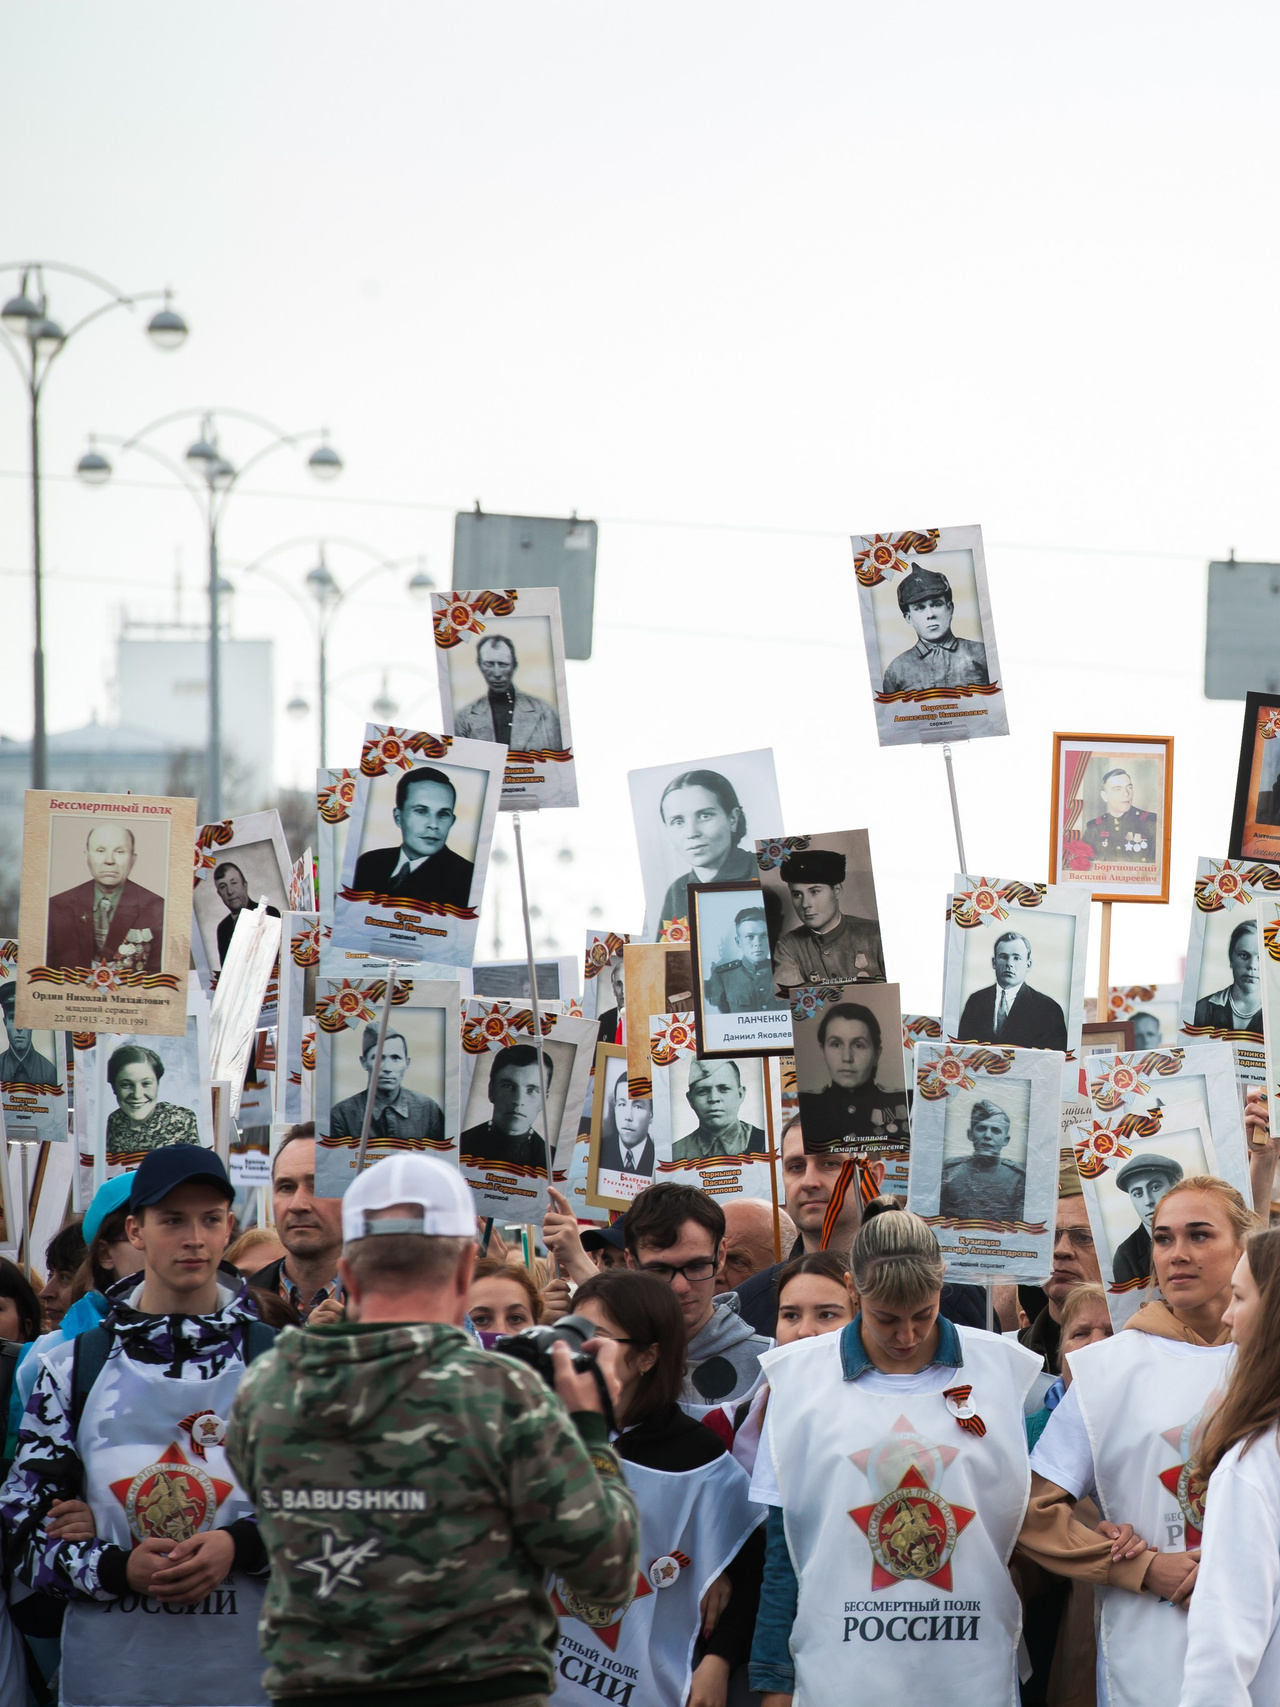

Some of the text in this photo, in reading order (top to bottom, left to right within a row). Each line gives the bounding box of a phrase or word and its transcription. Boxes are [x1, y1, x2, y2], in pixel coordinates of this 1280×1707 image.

[921, 703, 958, 712] Коротких
[894, 709, 988, 723] Александр Николаевич
[504, 766, 535, 775] йников
[504, 776, 545, 784] Иванович
[49, 799, 172, 814] Бессмертный полк
[1094, 863, 1157, 873] Бортновский
[1069, 872, 1157, 883] Василий Андреевич
[394, 911, 421, 924] Сухов
[364, 916, 448, 937] Василий Петрович
[389, 933, 416, 941] рядовой
[32, 991, 170, 1006] Ордин Николай Михайлович
[54, 1014, 97, 1024] 22.07.1913
[105, 1017, 148, 1026] 21.10.1991
[737, 1014, 788, 1024] ПАНЧЕНКО
[723, 1031, 793, 1042] Даниил Яковлев
[829, 1144, 904, 1153] Тамара Георгиевна
[485, 1173, 518, 1185] Немтин
[699, 1169, 742, 1179] Чернышев
[703, 1177, 738, 1187] Василий
[494, 1184, 538, 1198] Гордеевич
[701, 1186, 743, 1195] рхипович
[484, 1193, 509, 1201] рядовой
[959, 1236, 1001, 1247] Кузнецов
[969, 1246, 1038, 1258] Александрович
[261, 1489, 426, 1510] S. BABUSHKIN
[844, 1599, 981, 1612] БЕССМЕРТНЫЙ ПОЛК
[842, 1616, 981, 1642] РОССИИ
[602, 1657, 639, 1680] ПОЛК
[556, 1649, 636, 1707] СИИ
